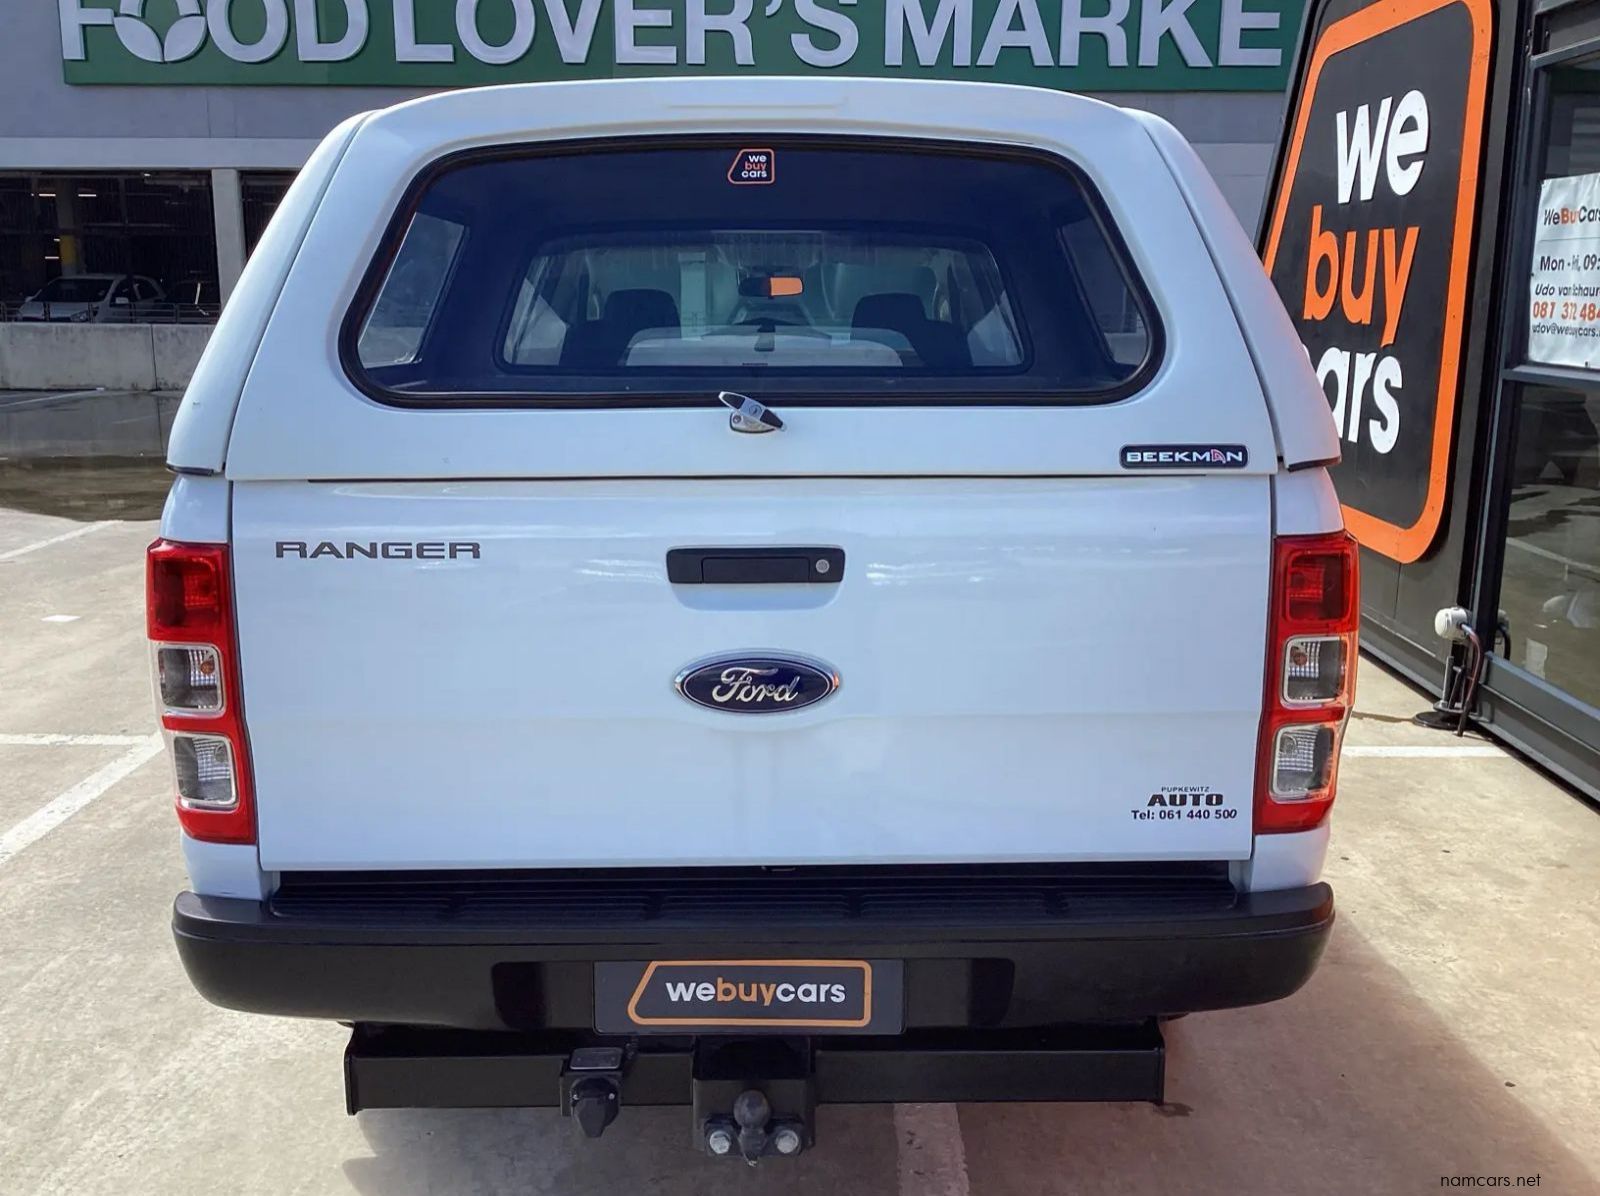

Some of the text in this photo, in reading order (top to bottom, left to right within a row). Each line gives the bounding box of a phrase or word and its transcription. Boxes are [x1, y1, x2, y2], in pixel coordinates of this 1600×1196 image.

[58, 0, 369, 62] FOOD
[1336, 90, 1429, 204] we
[741, 170, 767, 178] cars
[744, 161, 767, 171] buy
[1540, 255, 1565, 271] Mon
[1303, 204, 1420, 348] buy
[1535, 283, 1556, 296] Udo
[1302, 344, 1403, 454] ars
[1126, 449, 1243, 463] BEEKMAN
[275, 541, 481, 559] RANGER
[712, 667, 801, 702] Ford
[1147, 793, 1223, 806] AUTO
[1131, 809, 1237, 820] Tel: 061 440 500
